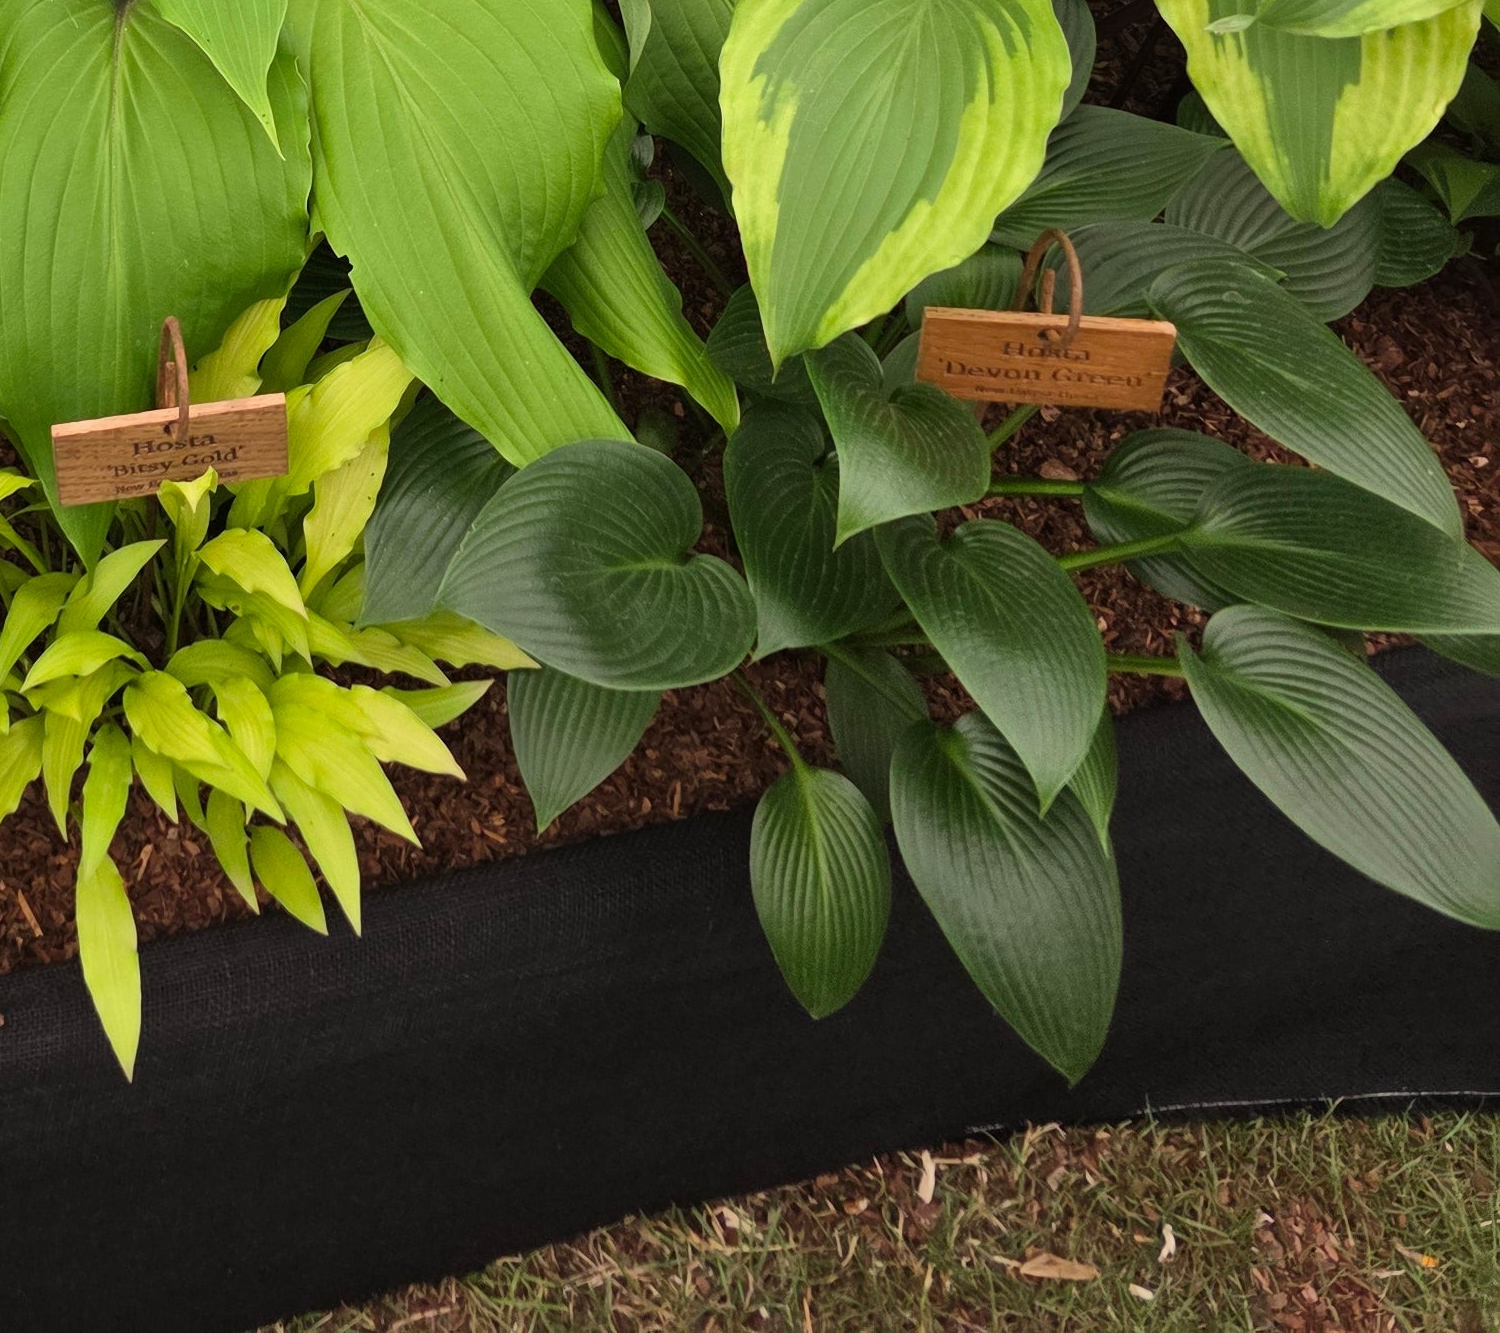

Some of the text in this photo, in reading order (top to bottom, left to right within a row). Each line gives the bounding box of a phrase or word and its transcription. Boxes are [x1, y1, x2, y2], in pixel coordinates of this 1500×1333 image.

[1002, 341, 1091, 362] Hosta
[938, 357, 1042, 382] 'Devon
[131, 434, 218, 457] Hosta
[107, 444, 245, 479] 'Bitsy Gold'
